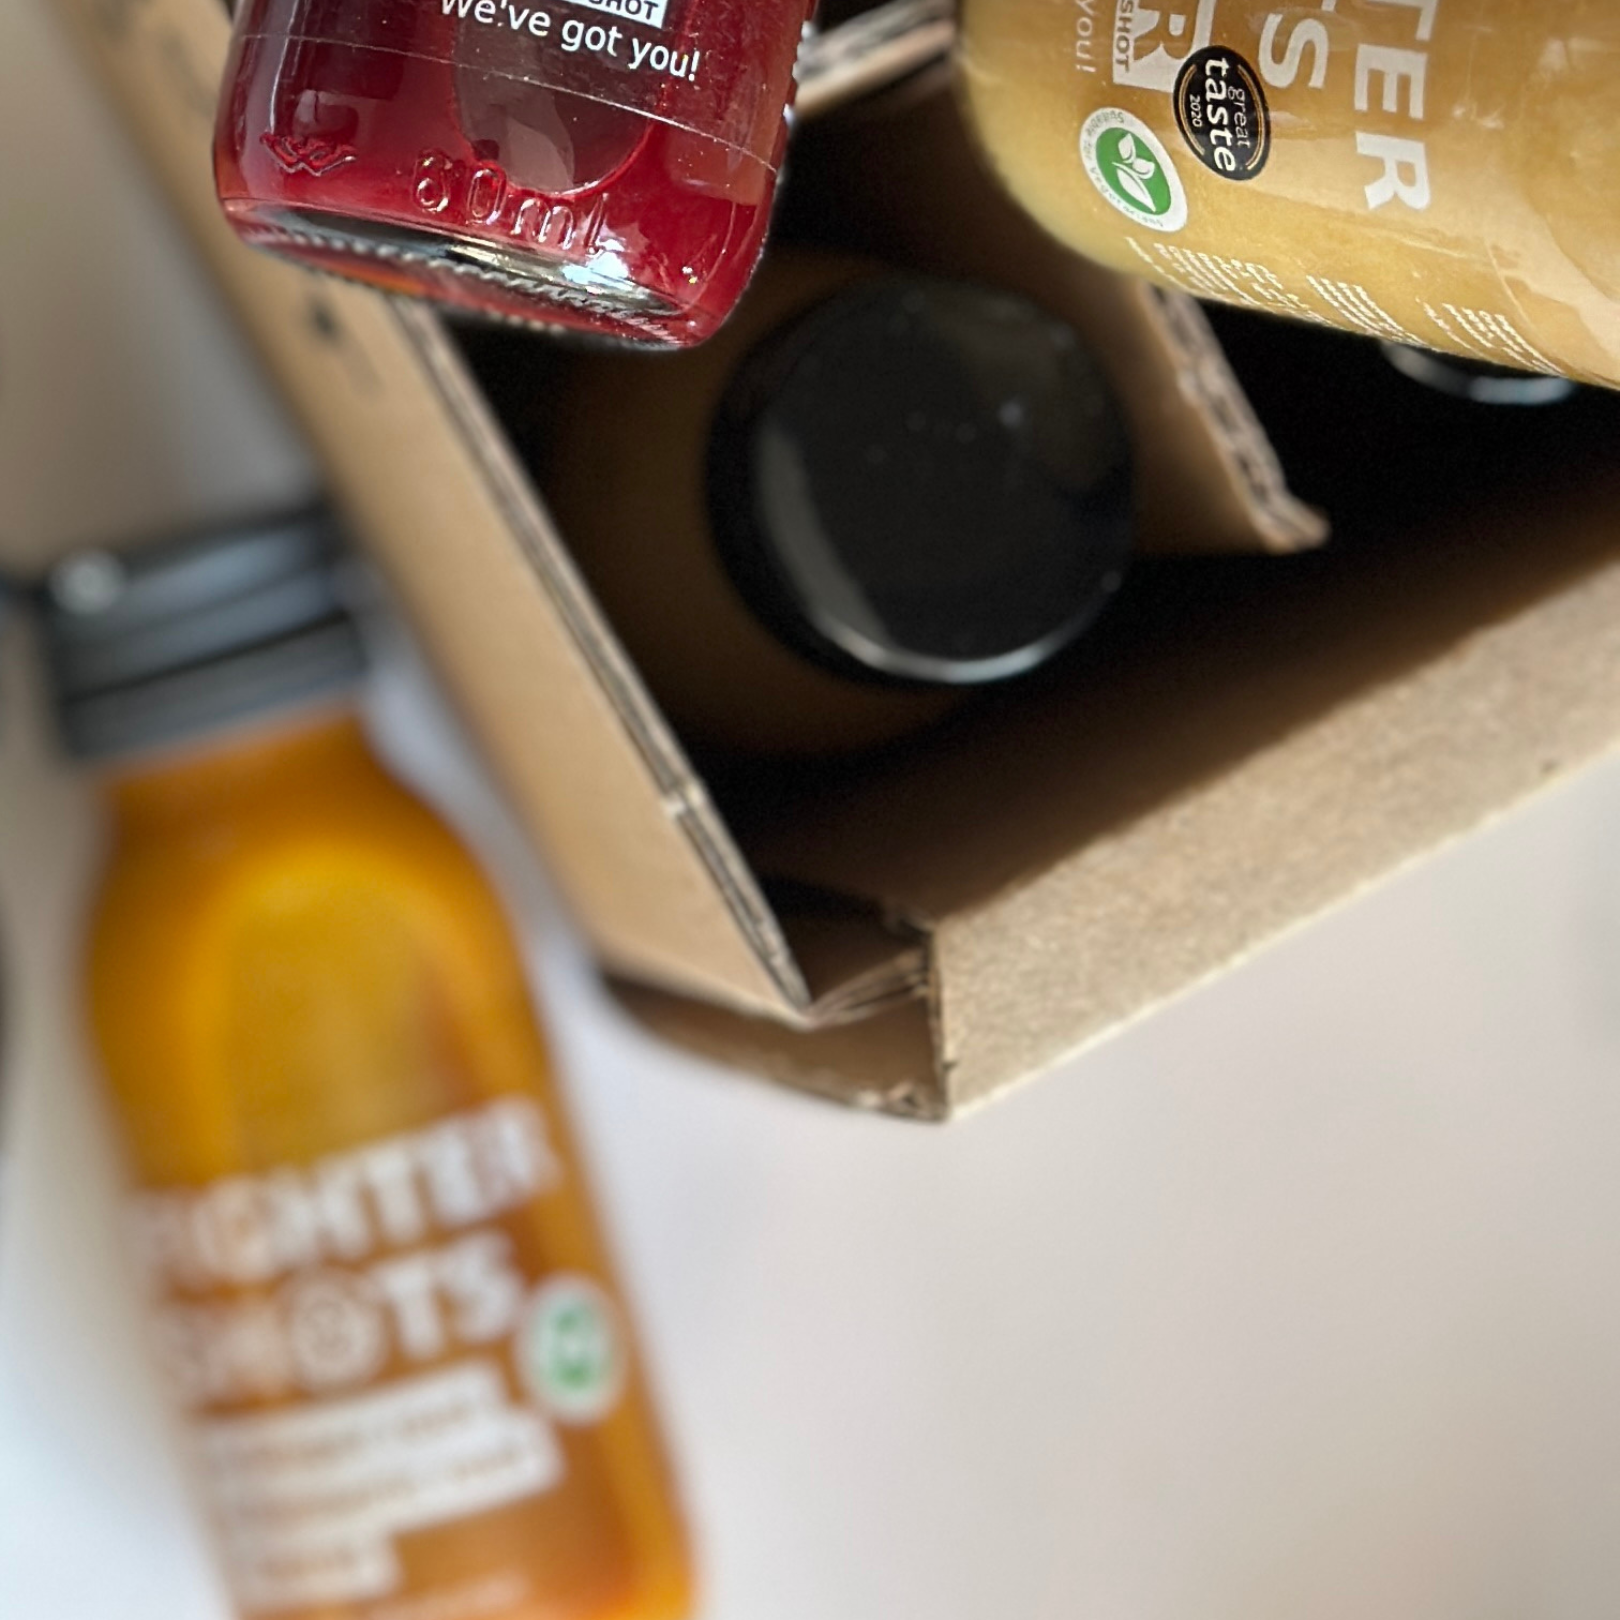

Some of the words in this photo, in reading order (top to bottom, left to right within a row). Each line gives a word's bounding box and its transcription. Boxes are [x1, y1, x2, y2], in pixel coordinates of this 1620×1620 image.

[561, 20, 622, 61] got
[630, 37, 701, 82] you!
[1116, 0, 1134, 72] SHOT
[1190, 94, 1202, 127] 2020
[1205, 57, 1237, 172] taste
[1228, 86, 1250, 149] great
